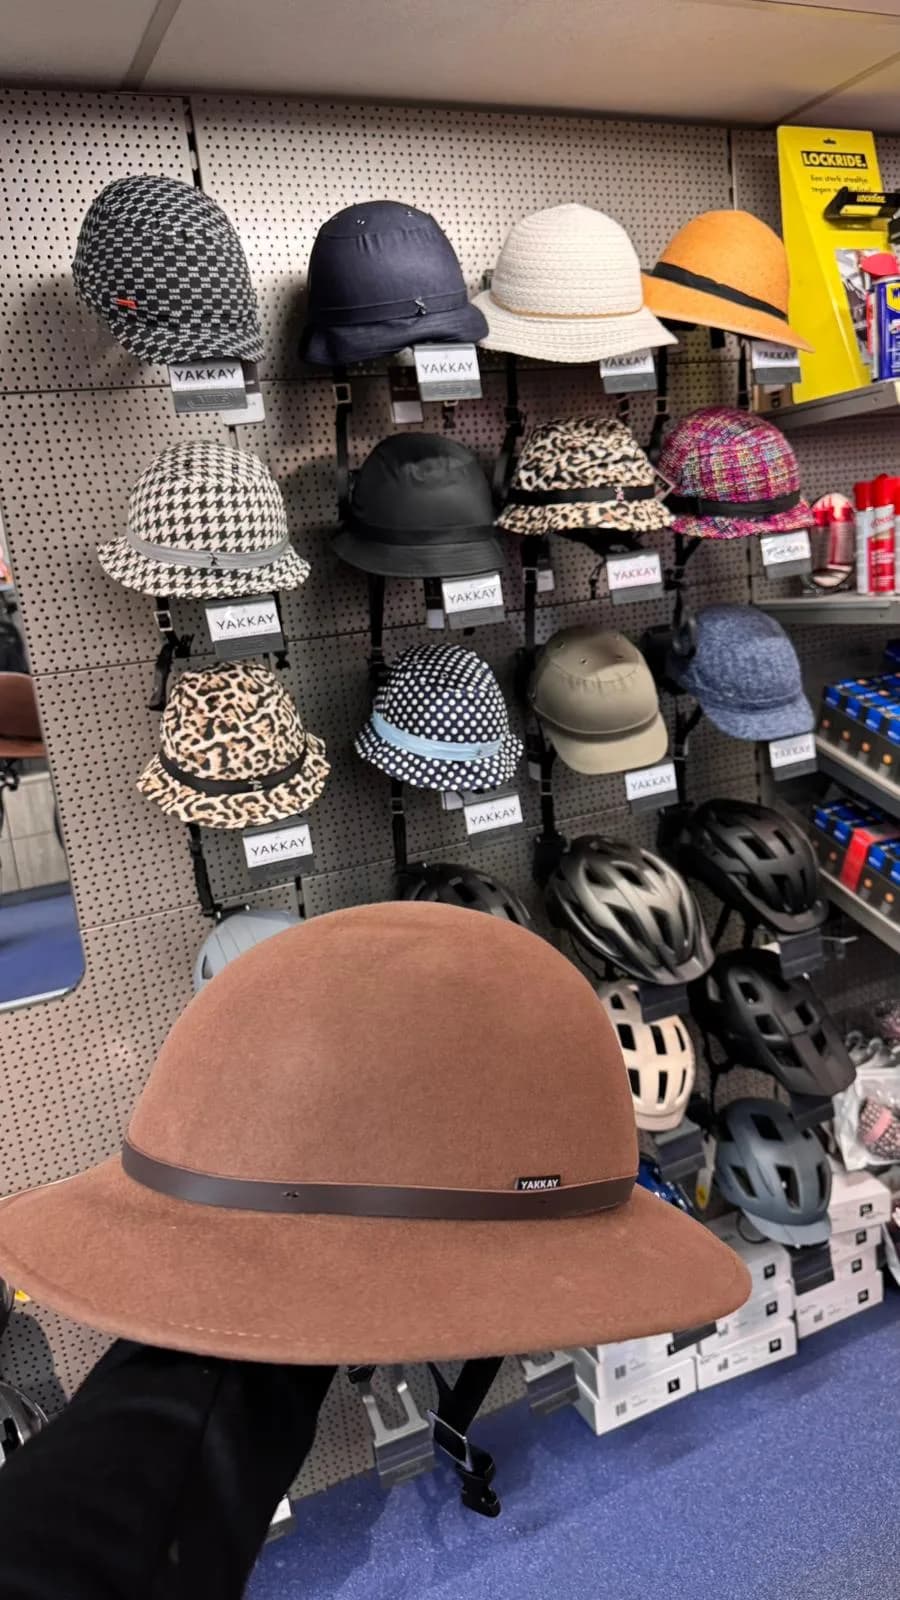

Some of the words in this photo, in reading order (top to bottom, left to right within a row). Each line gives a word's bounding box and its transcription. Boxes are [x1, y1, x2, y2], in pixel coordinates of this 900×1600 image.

[421, 362, 473, 374] YAKKAY
[602, 356, 648, 369] YAKKAY
[174, 368, 236, 382] YAKKAY
[613, 567, 657, 582] YAKKAY
[448, 588, 498, 604] YAKKAY
[216, 613, 275, 631] YAKKAY
[631, 774, 673, 792] YAKKAY
[470, 807, 517, 825] YAKKAY
[251, 836, 306, 857] YAKKAY
[521, 1179, 559, 1190] YAKKAY
